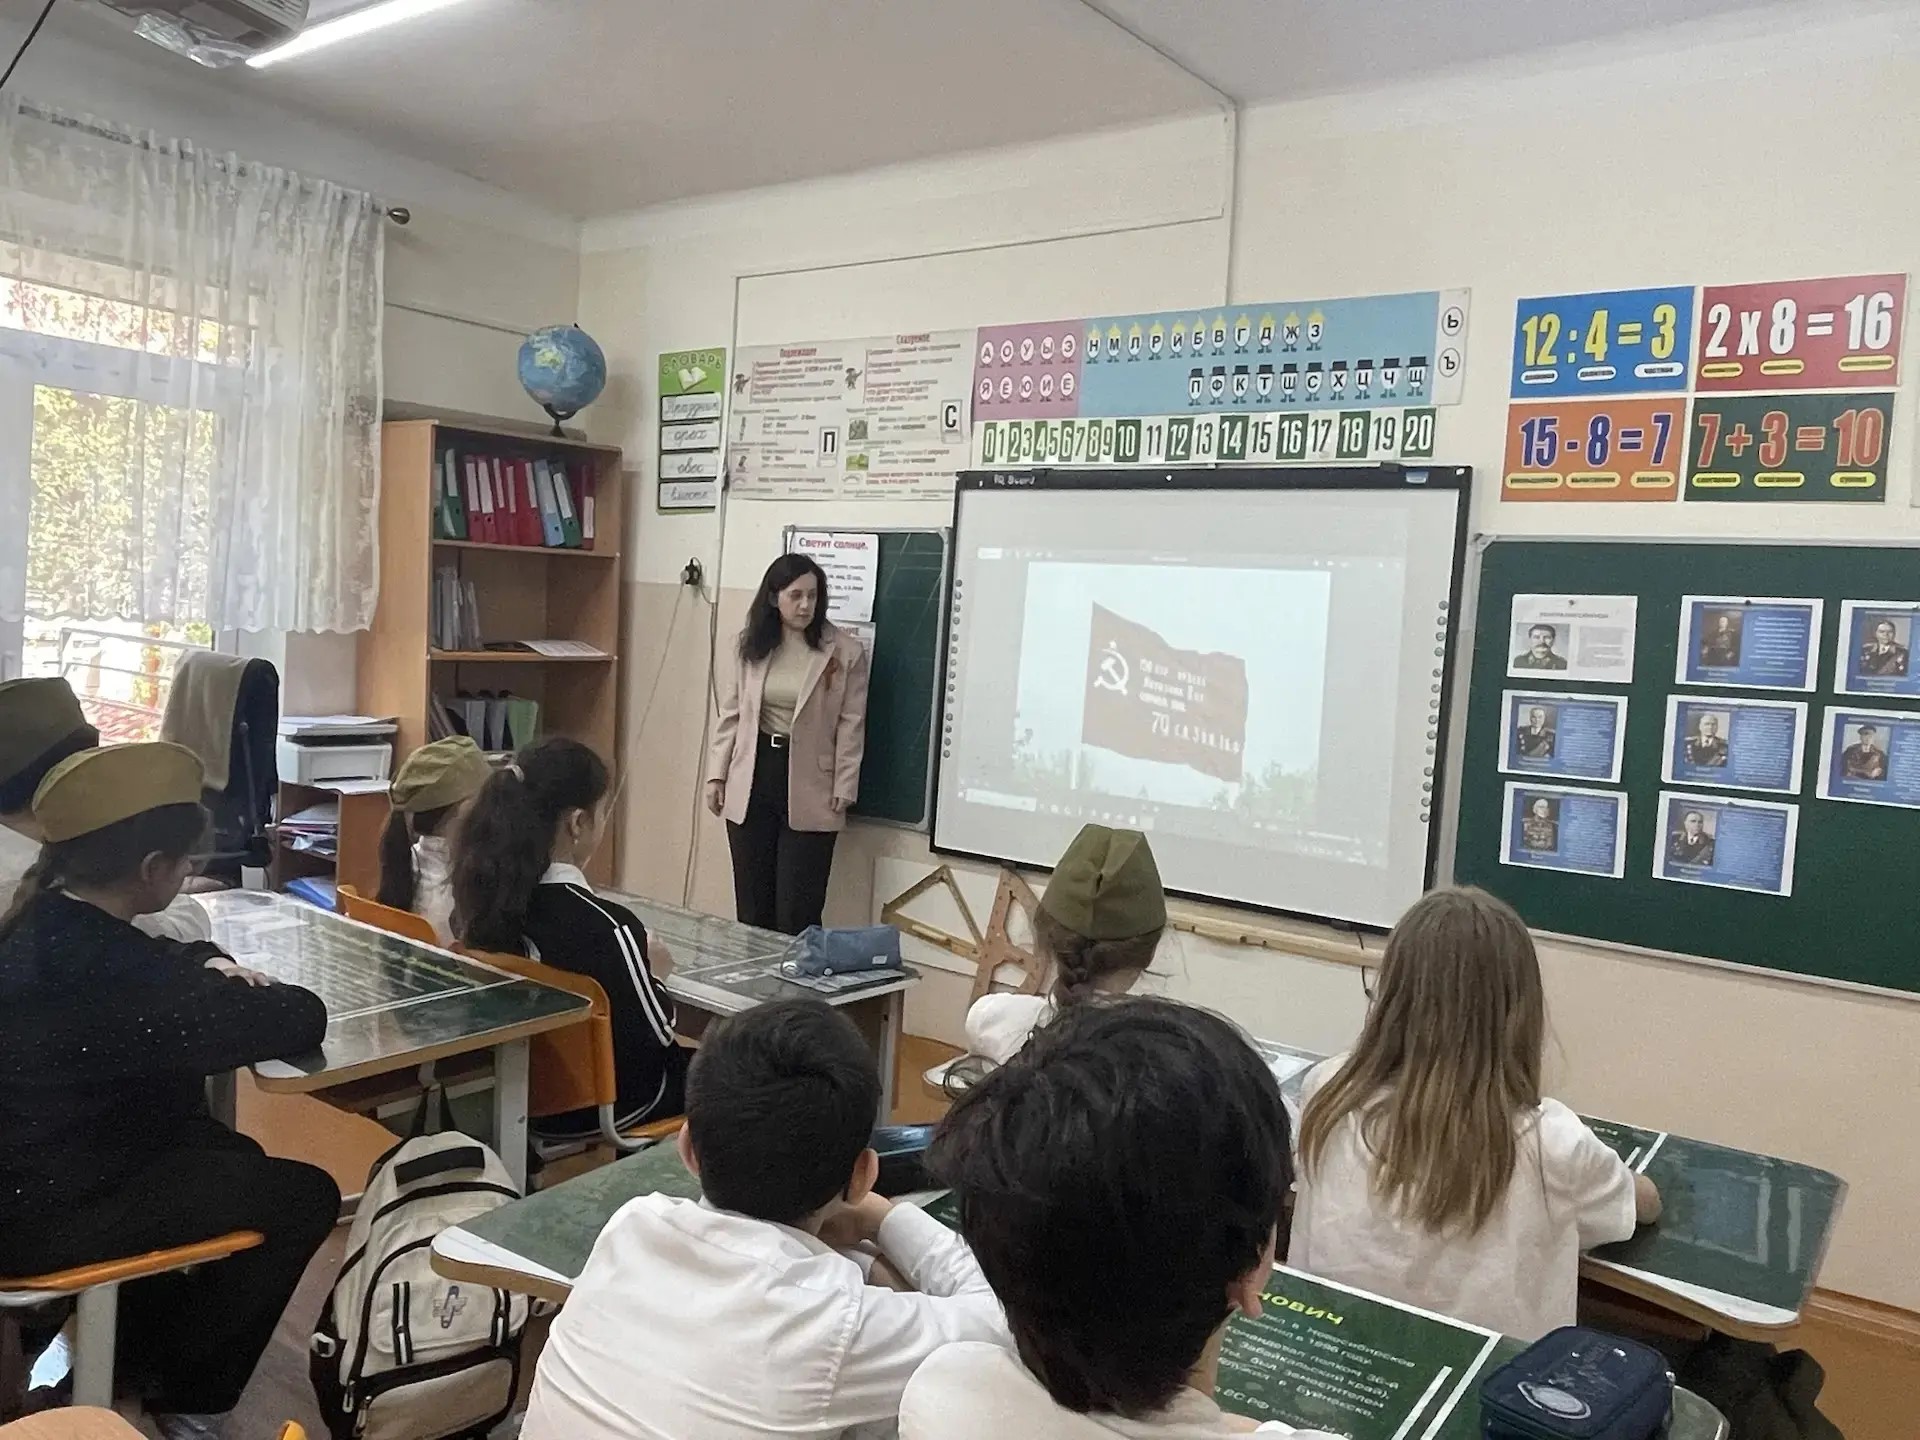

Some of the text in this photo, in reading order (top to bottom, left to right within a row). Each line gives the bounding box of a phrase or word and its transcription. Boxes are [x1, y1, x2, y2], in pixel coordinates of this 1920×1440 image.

[1089, 339, 1099, 352] Н
[1109, 338, 1120, 350] М
[1130, 336, 1140, 350] Л
[1151, 335, 1161, 348] Р
[1193, 331, 1203, 345] Б
[1214, 330, 1224, 342] В
[1237, 328, 1247, 341] Г
[1261, 327, 1271, 340] Д
[1286, 325, 1298, 339] Ж
[1521, 312, 1561, 367] 12
[1584, 310, 1609, 361] 4
[1651, 304, 1677, 359] 3
[1705, 303, 1731, 358] 2
[1769, 299, 1797, 354] 8
[1844, 292, 1894, 350] 16
[982, 340, 1073, 359] А О У Ы Э
[661, 352, 722, 376] СЛОВАРЬ
[981, 381, 990, 394] Я
[1042, 380, 1051, 392] И
[1191, 369, 1422, 393] П Ф К Т Ш С Х Ц Ч Щ
[823, 431, 835, 453] П
[1117, 425, 1136, 457] 10
[1147, 425, 1162, 456] 11
[1170, 424, 1189, 456] 12
[1195, 422, 1213, 454] 13
[1221, 420, 1242, 454] 14
[1251, 421, 1272, 453] 15
[1281, 419, 1302, 454] 16
[1311, 419, 1332, 452] 17
[1341, 417, 1364, 452] 18
[1374, 416, 1396, 451] 19
[1404, 415, 1432, 451] 20
[1520, 416, 1559, 468] 15
[1585, 414, 1612, 468] 8
[1651, 413, 1673, 465] 7
[1697, 413, 1721, 468] 7
[1759, 410, 1788, 468] 3
[1833, 407, 1885, 467] 10
[799, 537, 831, 548] Светит
[1307, 1326, 1416, 1368] Новосибирское
